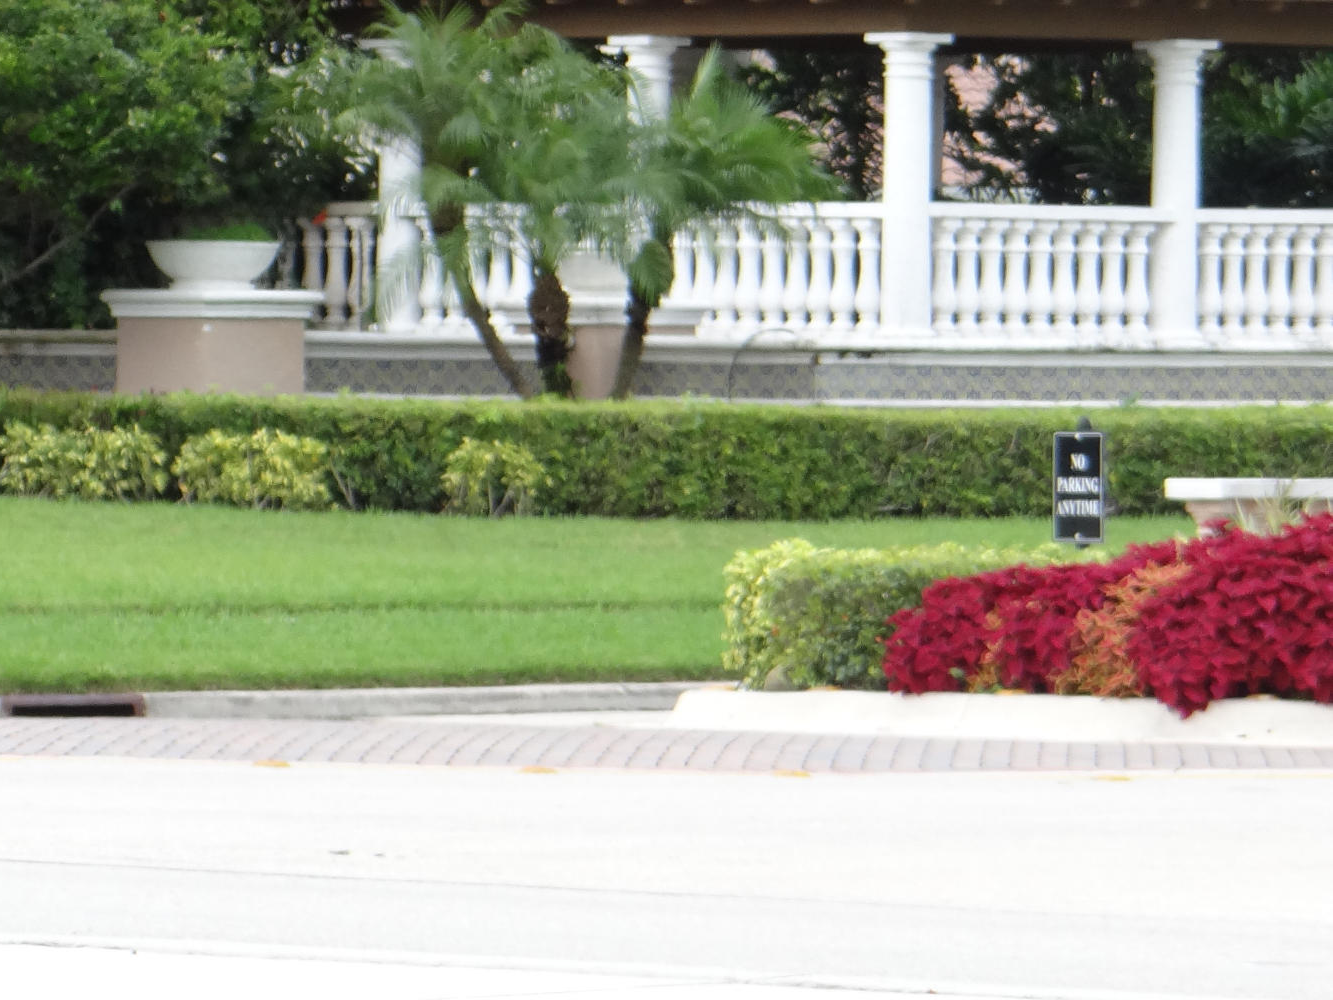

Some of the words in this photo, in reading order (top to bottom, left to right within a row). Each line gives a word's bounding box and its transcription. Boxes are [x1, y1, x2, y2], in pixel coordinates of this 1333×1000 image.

[1070, 453, 1088, 470] NO
[1057, 477, 1099, 493] PARKING
[1057, 500, 1100, 516] ANYTIME
